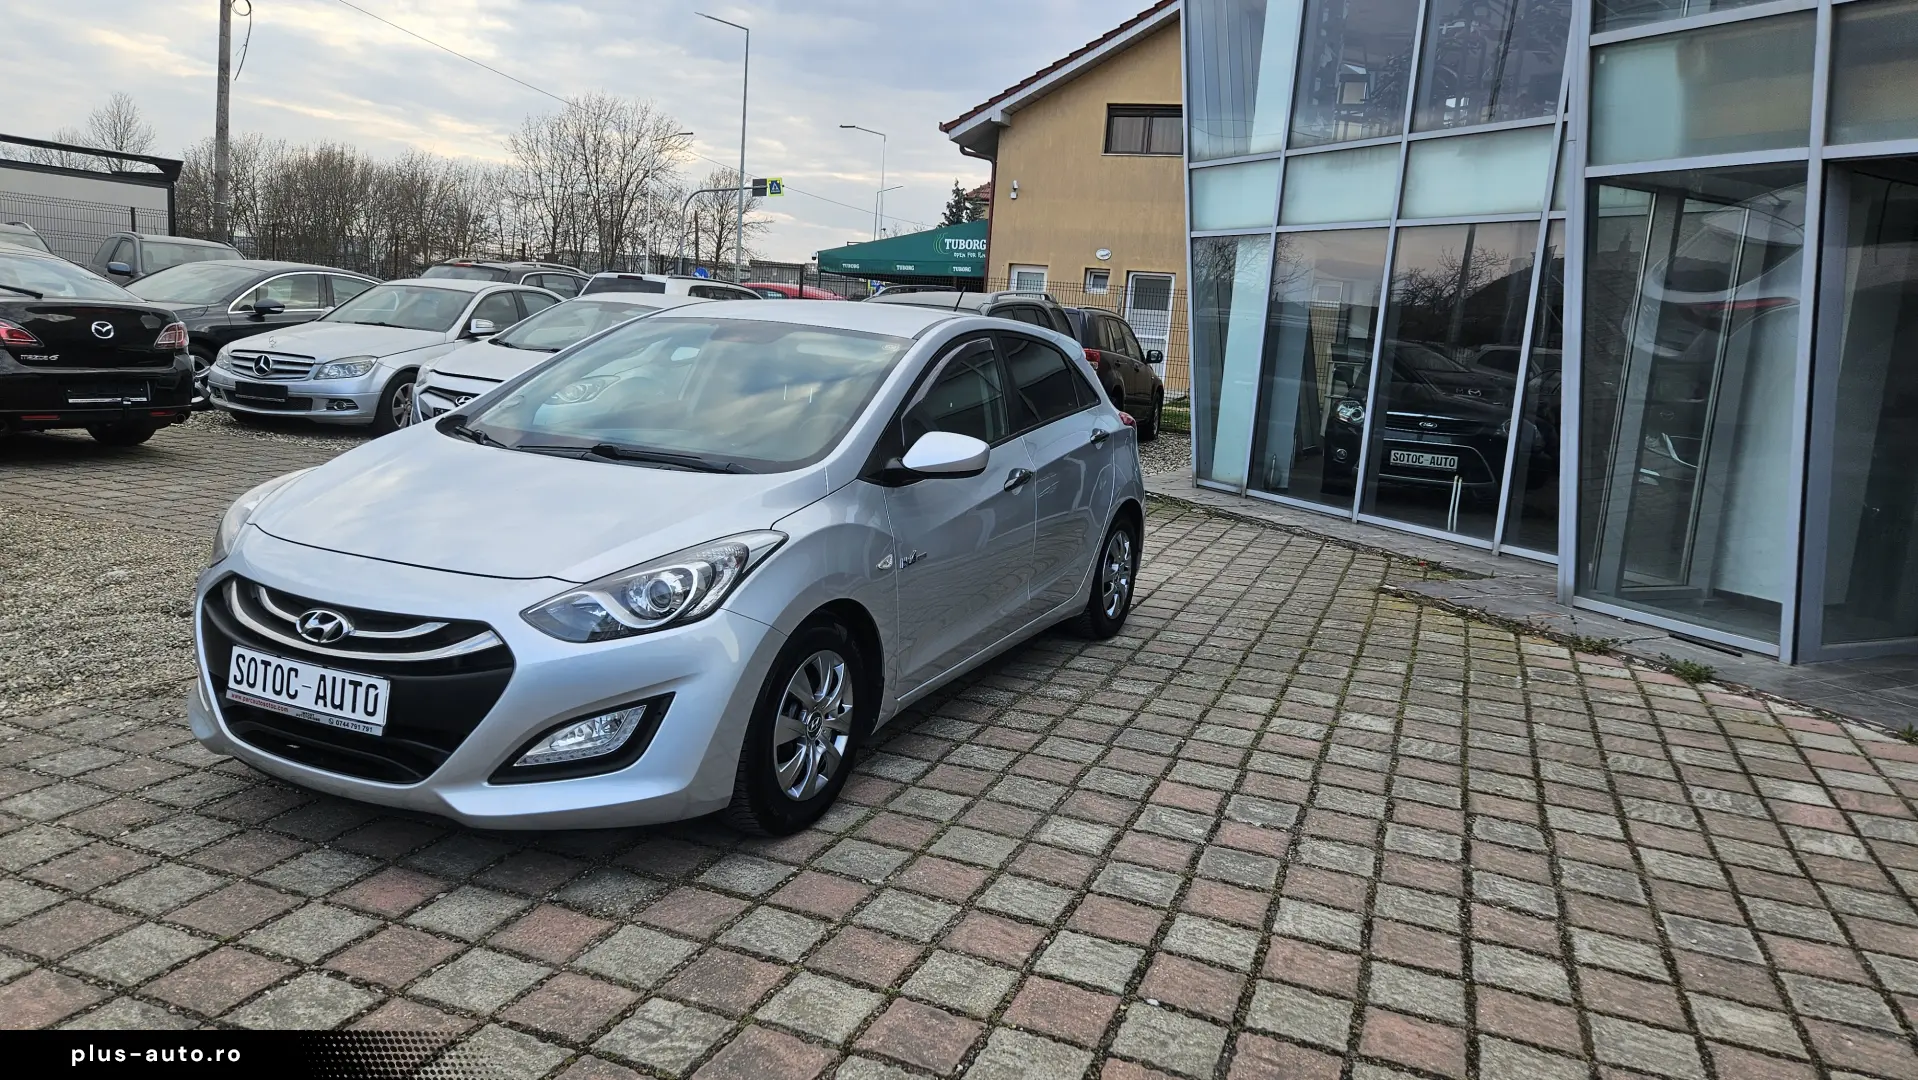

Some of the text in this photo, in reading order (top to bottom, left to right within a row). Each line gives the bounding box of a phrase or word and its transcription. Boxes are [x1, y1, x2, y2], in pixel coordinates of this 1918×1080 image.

[944, 238, 987, 250] TUBORG
[335, 720, 349, 728] 0744
[350, 722, 361, 730] 791
